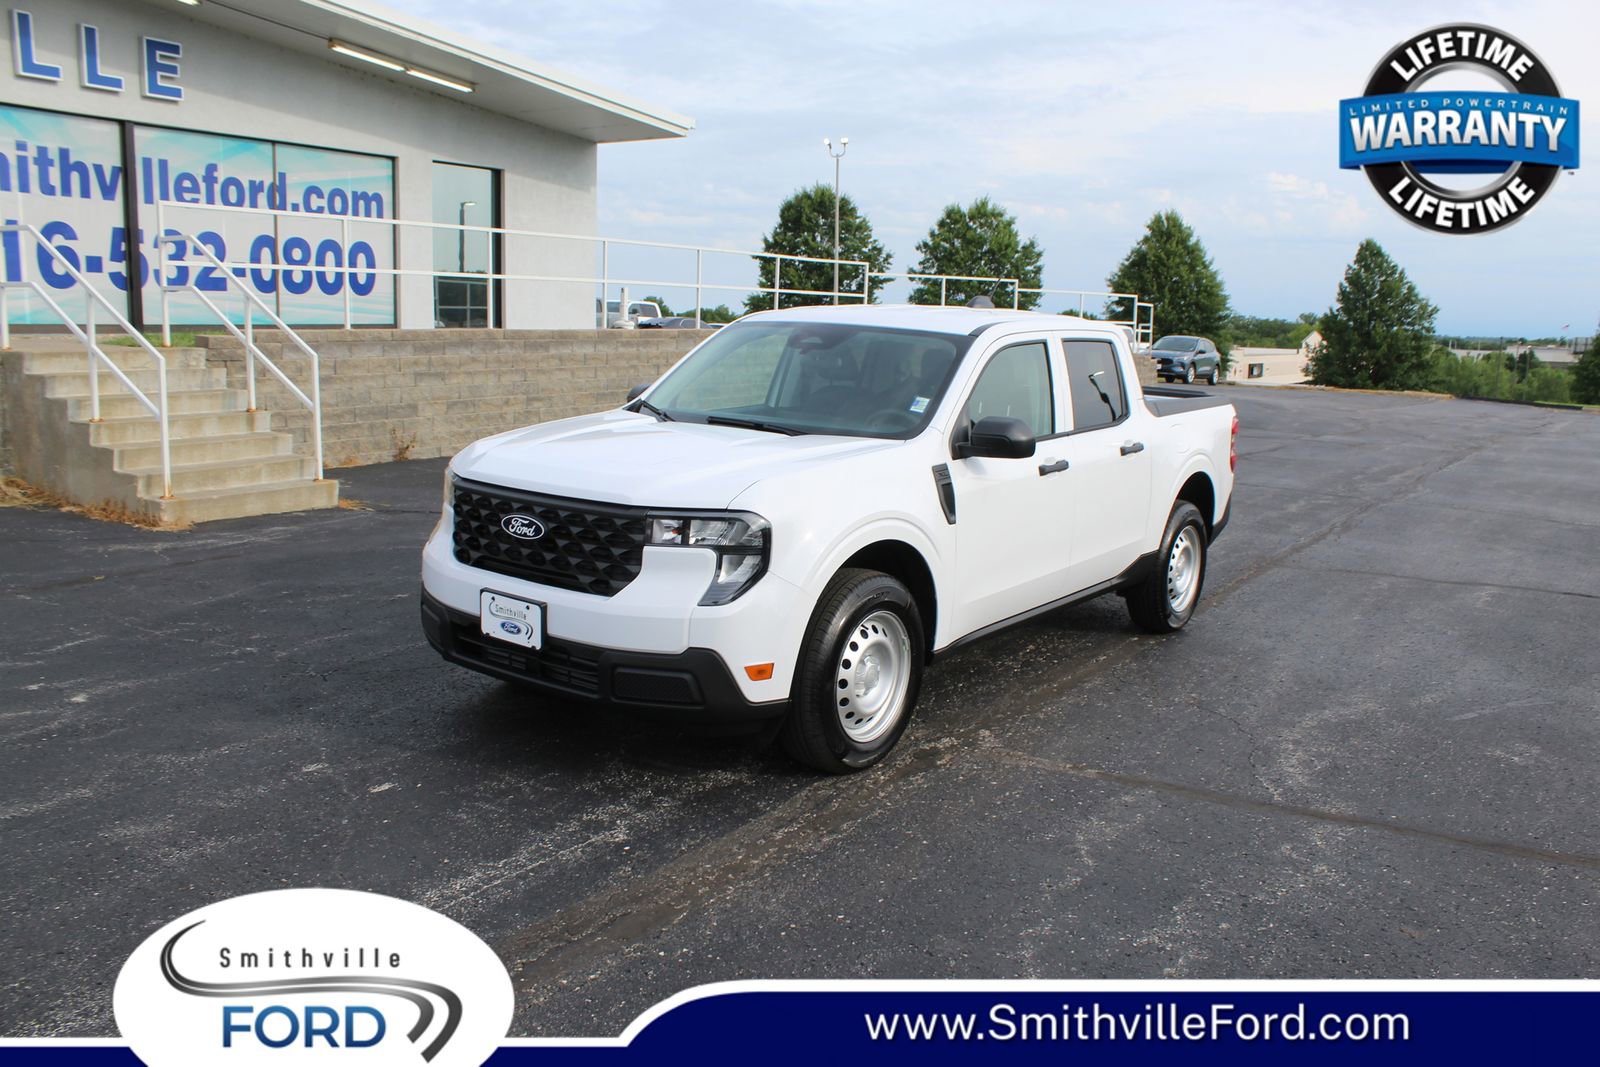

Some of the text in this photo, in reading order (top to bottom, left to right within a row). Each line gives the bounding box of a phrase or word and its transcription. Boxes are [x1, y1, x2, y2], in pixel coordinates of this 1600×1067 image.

[12, 10, 184, 101] LLE
[0, 140, 383, 218] ithvlleford.com
[508, 517, 536, 537] Ford
[495, 604, 527, 620] Smithville
